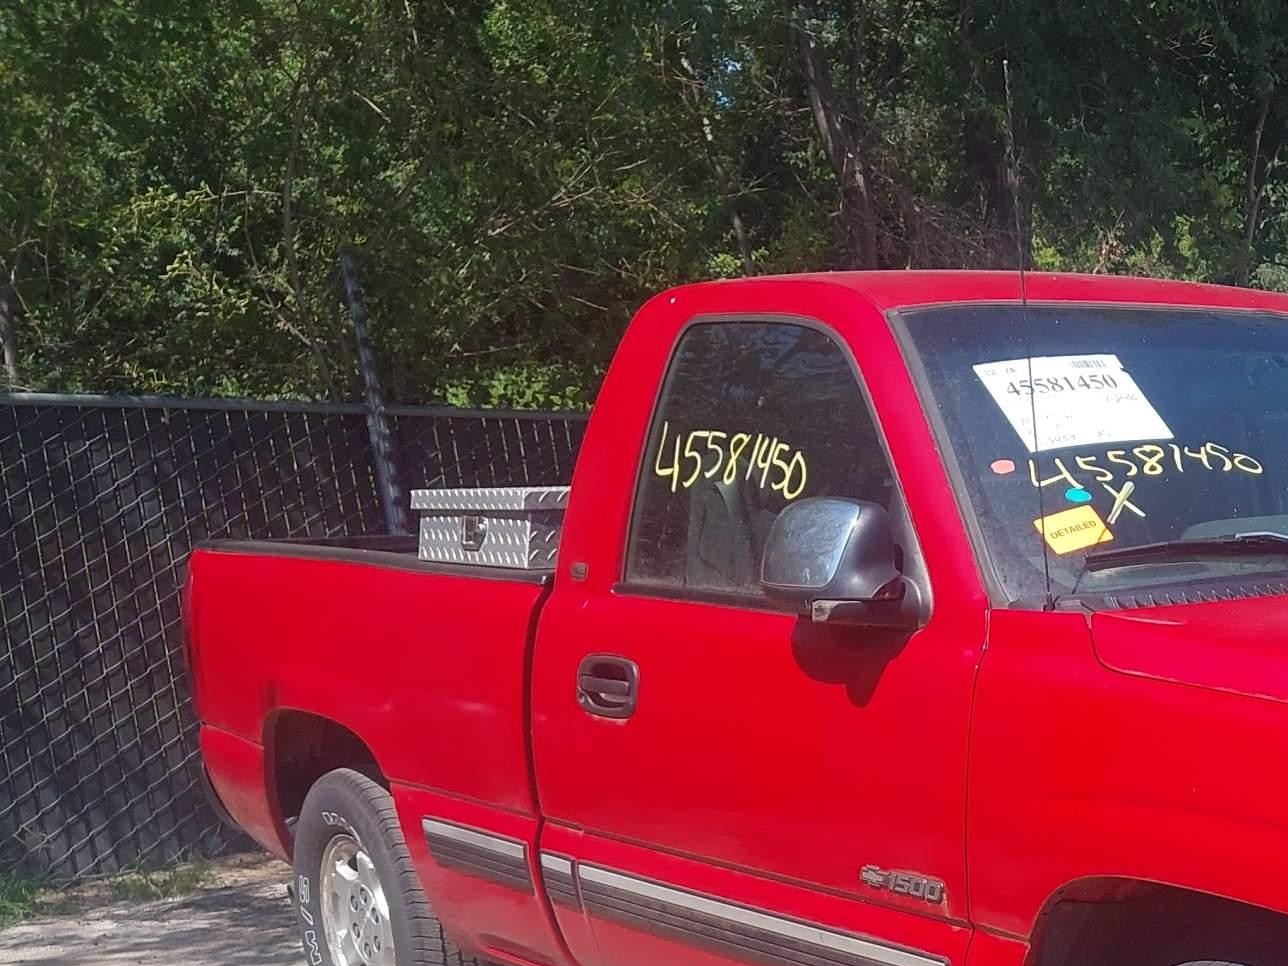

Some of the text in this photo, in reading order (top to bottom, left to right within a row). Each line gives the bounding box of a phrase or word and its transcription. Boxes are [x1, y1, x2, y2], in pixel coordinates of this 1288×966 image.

[1007, 373, 1118, 396] 45581450
[655, 421, 807, 500] 45581450
[1029, 442, 1264, 490] 45581450
[1049, 520, 1097, 540] DETAILED
[887, 872, 944, 903] 1500
